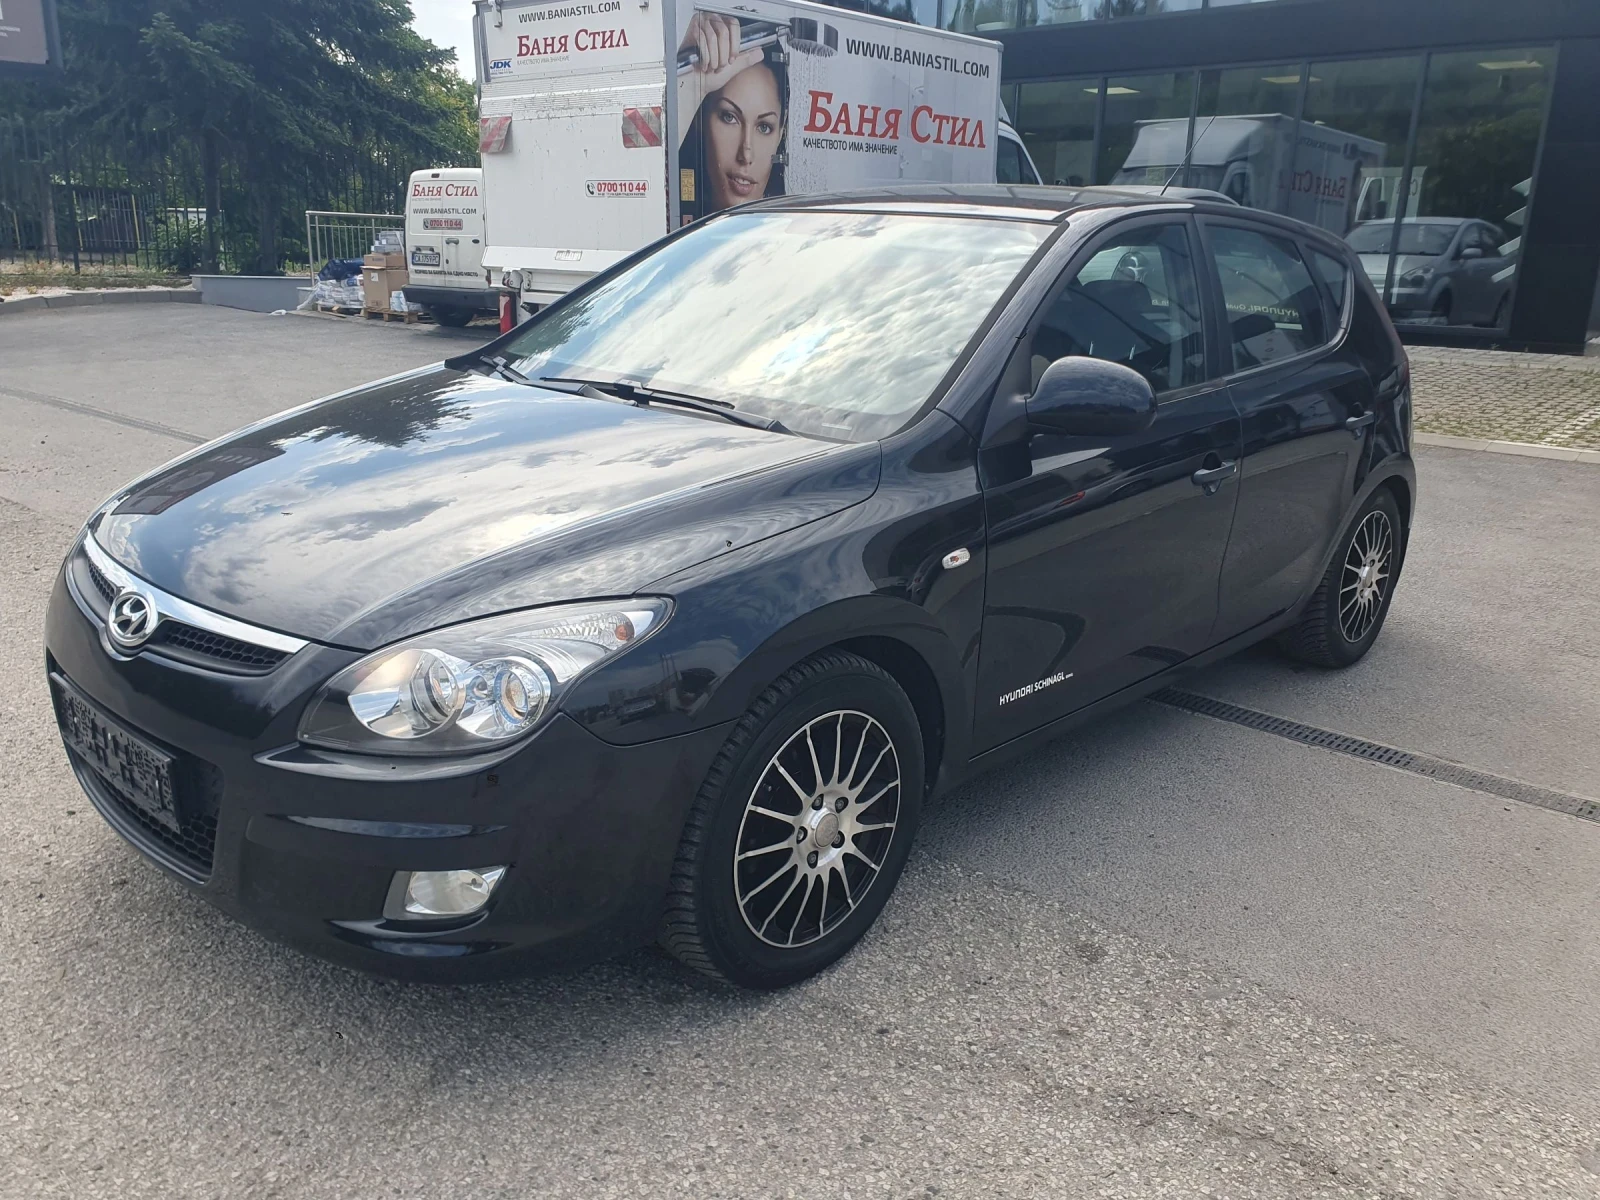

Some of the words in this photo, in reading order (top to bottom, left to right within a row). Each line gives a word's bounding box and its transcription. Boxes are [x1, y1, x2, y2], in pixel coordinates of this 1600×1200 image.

[518, 1, 621, 24] WWW.BANIASTIL.COM
[489, 60, 512, 69] JDK
[846, 38, 990, 79] WWW.BANIASTIL.COM
[803, 137, 847, 151] КАЧЕСТВОТО
[848, 140, 864, 152] ИМА
[864, 141, 898, 155] ЗНАЧЕНИЕ
[597, 182, 618, 192] 0700
[618, 182, 627, 192] 11
[628, 182, 634, 192] 0
[635, 182, 647, 192] 44
[999, 683, 1034, 706] HYUNDAI
[1034, 671, 1065, 692] SCHINAGL
